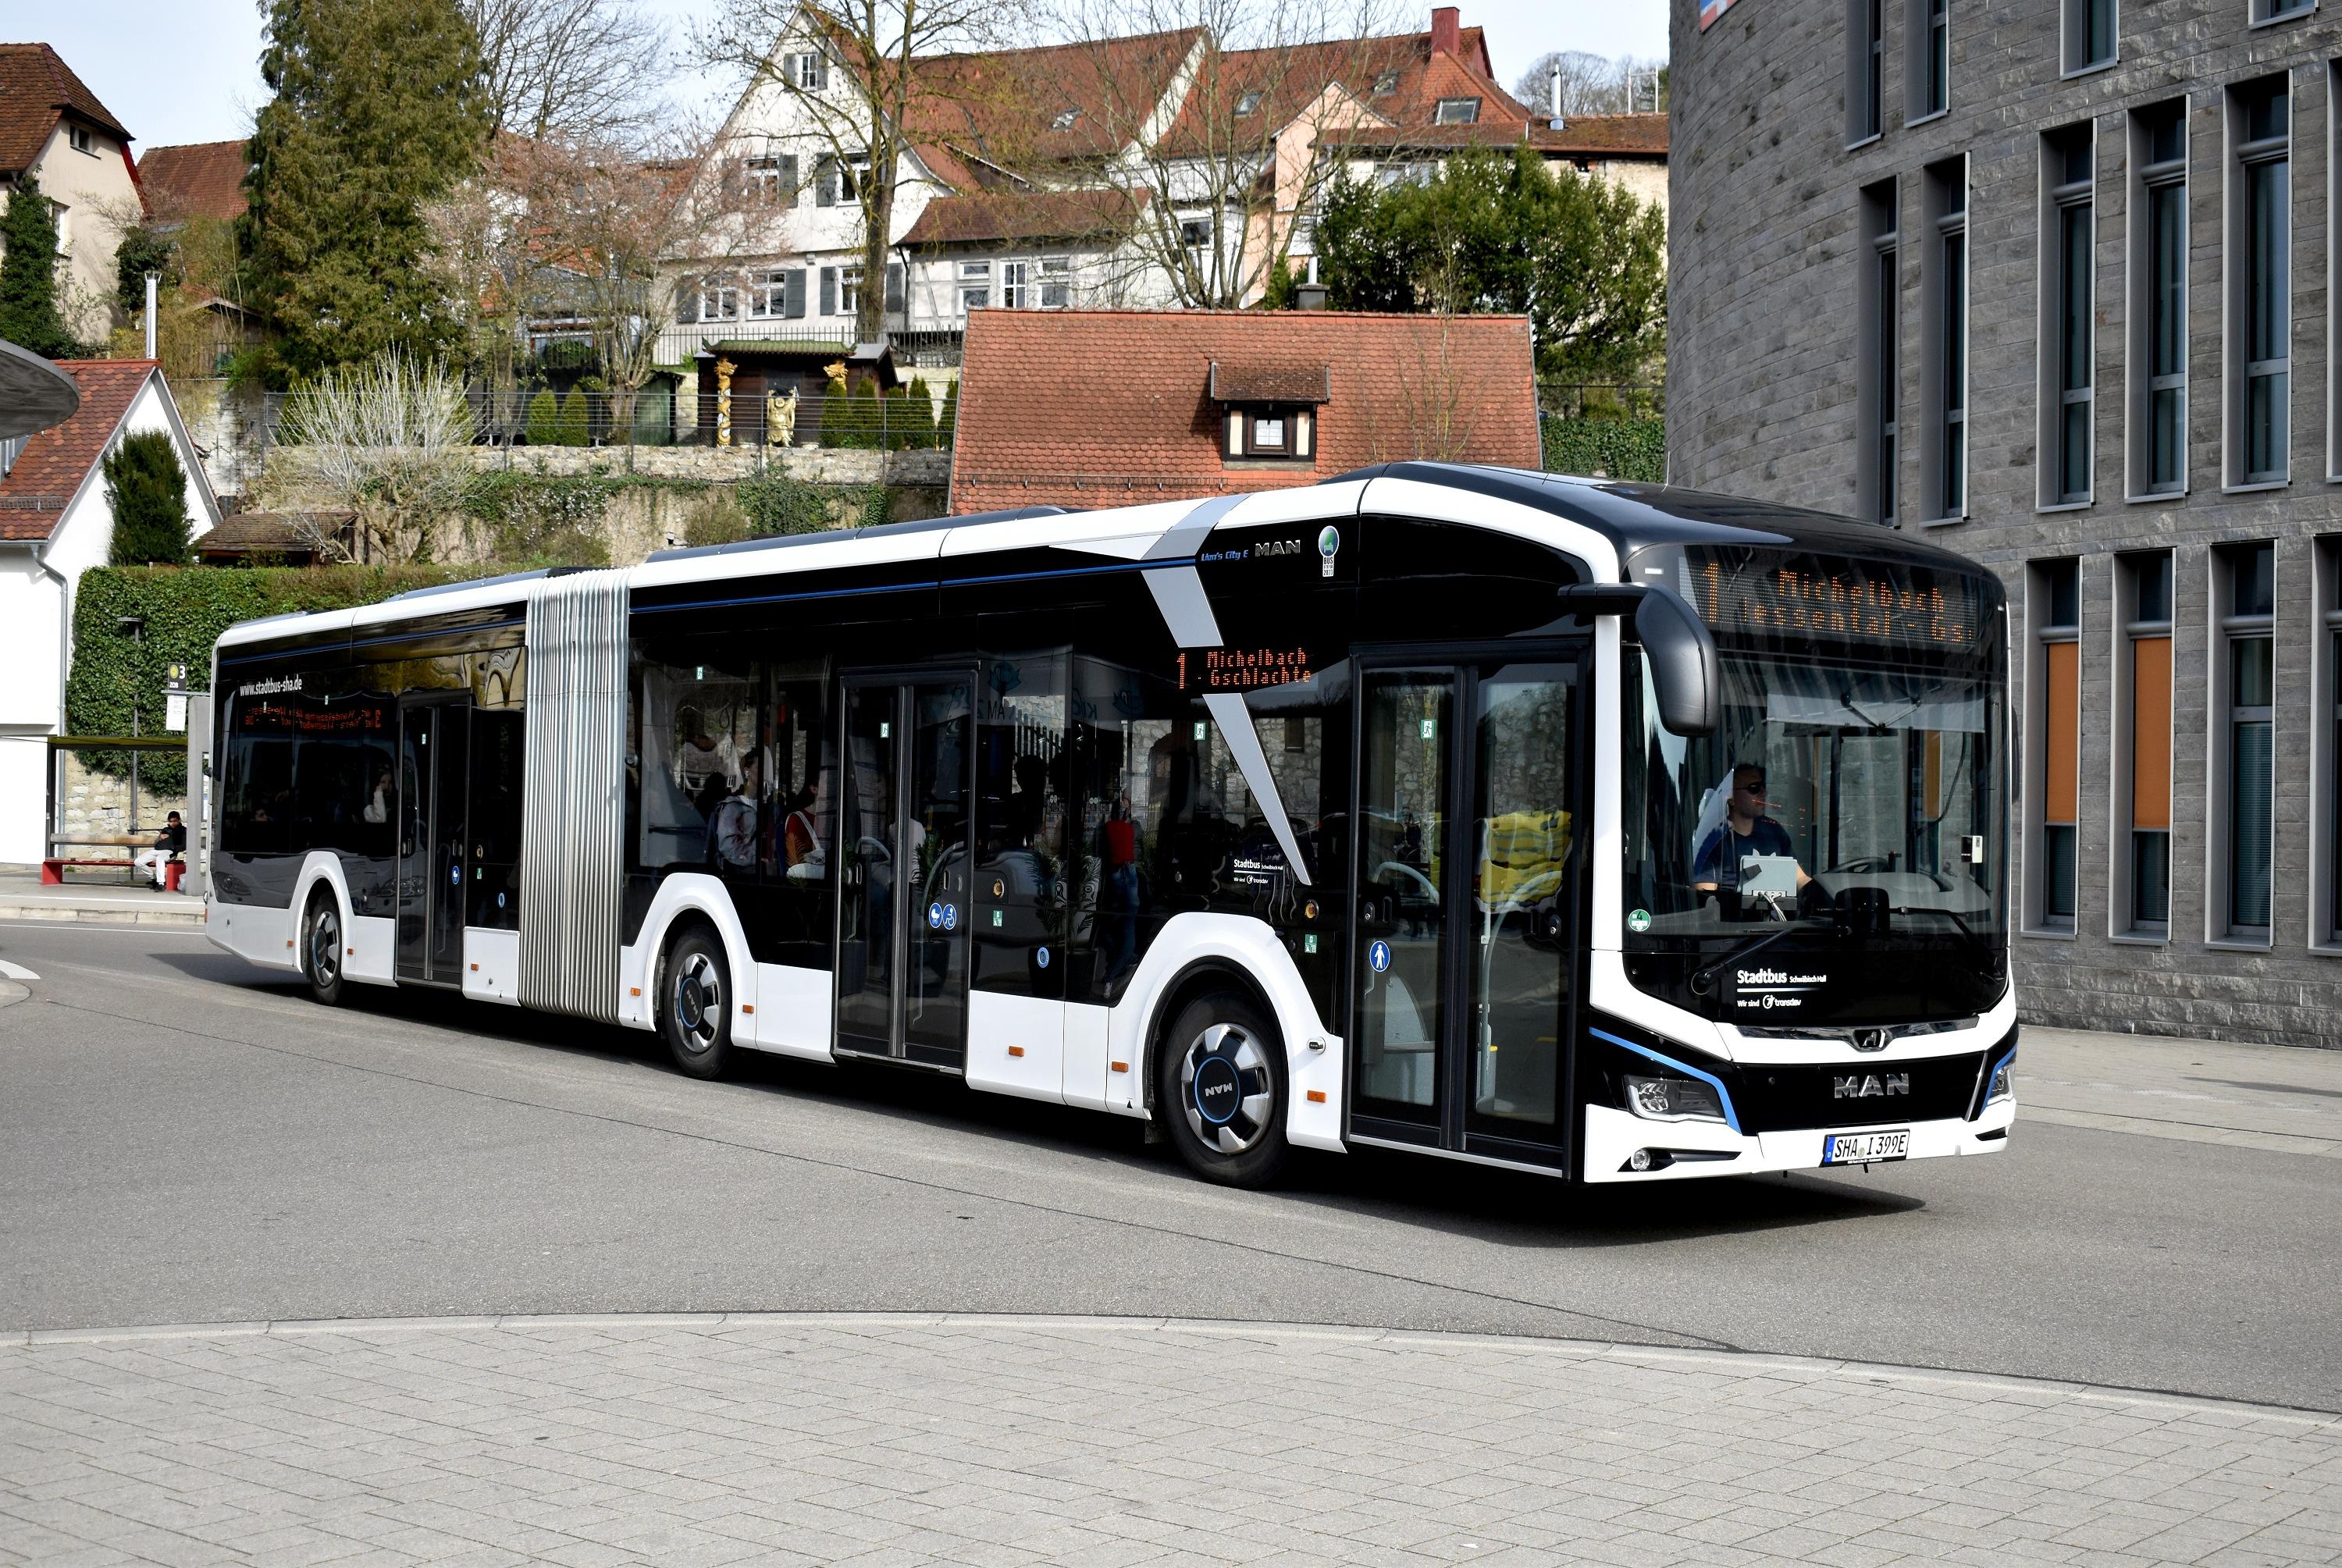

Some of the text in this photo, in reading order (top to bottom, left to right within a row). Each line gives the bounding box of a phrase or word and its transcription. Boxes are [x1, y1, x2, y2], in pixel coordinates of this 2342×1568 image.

[1255, 539, 1301, 556] MAN
[1703, 563, 1718, 622] 1
[1779, 571, 1944, 613] Michelbach
[1743, 596, 1890, 635] essental
[1207, 647, 1306, 668] Michelbach
[179, 665, 186, 679] 3
[1176, 652, 1186, 689] 1
[1211, 666, 1312, 685] Gschlachte
[240, 674, 302, 696] www.stadtbus-sha.de
[1233, 859, 1260, 869] Stadtbus
[1636, 911, 1643, 921] 4
[1737, 968, 1788, 983] Stadtbus
[1789, 975, 1817, 983] Schwäbisch
[1774, 998, 1801, 1007] transdev
[1205, 1083, 1233, 1097] MAN
[1834, 1073, 1910, 1098] MAN
[1835, 1139, 1858, 1158] SHA
[1876, 1135, 1906, 1154] 399E
